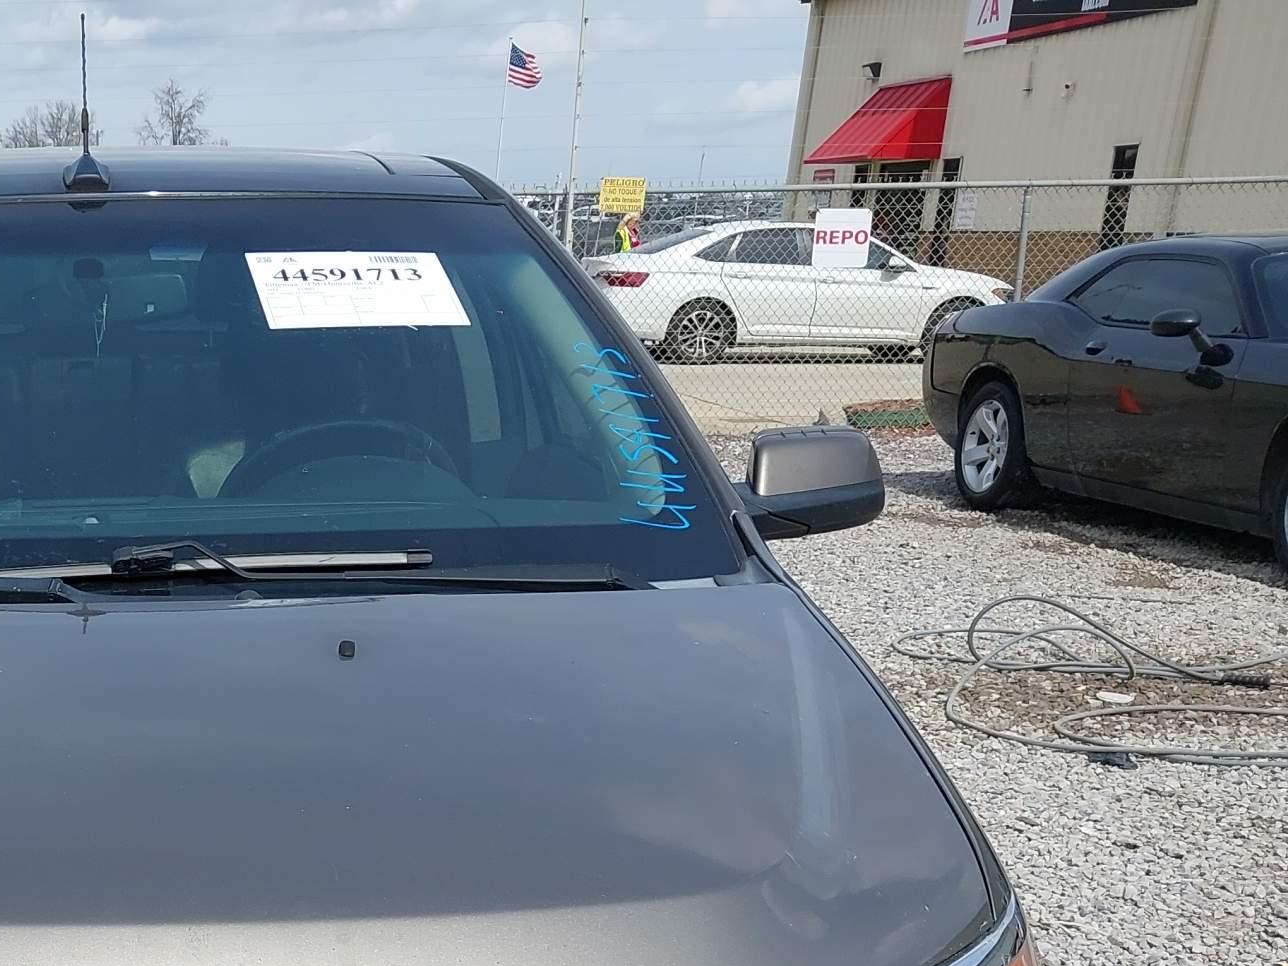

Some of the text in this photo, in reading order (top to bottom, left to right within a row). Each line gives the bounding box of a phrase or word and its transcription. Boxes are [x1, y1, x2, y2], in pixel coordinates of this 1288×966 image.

[604, 178, 645, 187] PELIGRO
[815, 229, 869, 246] REPO
[273, 268, 423, 281] 44591713
